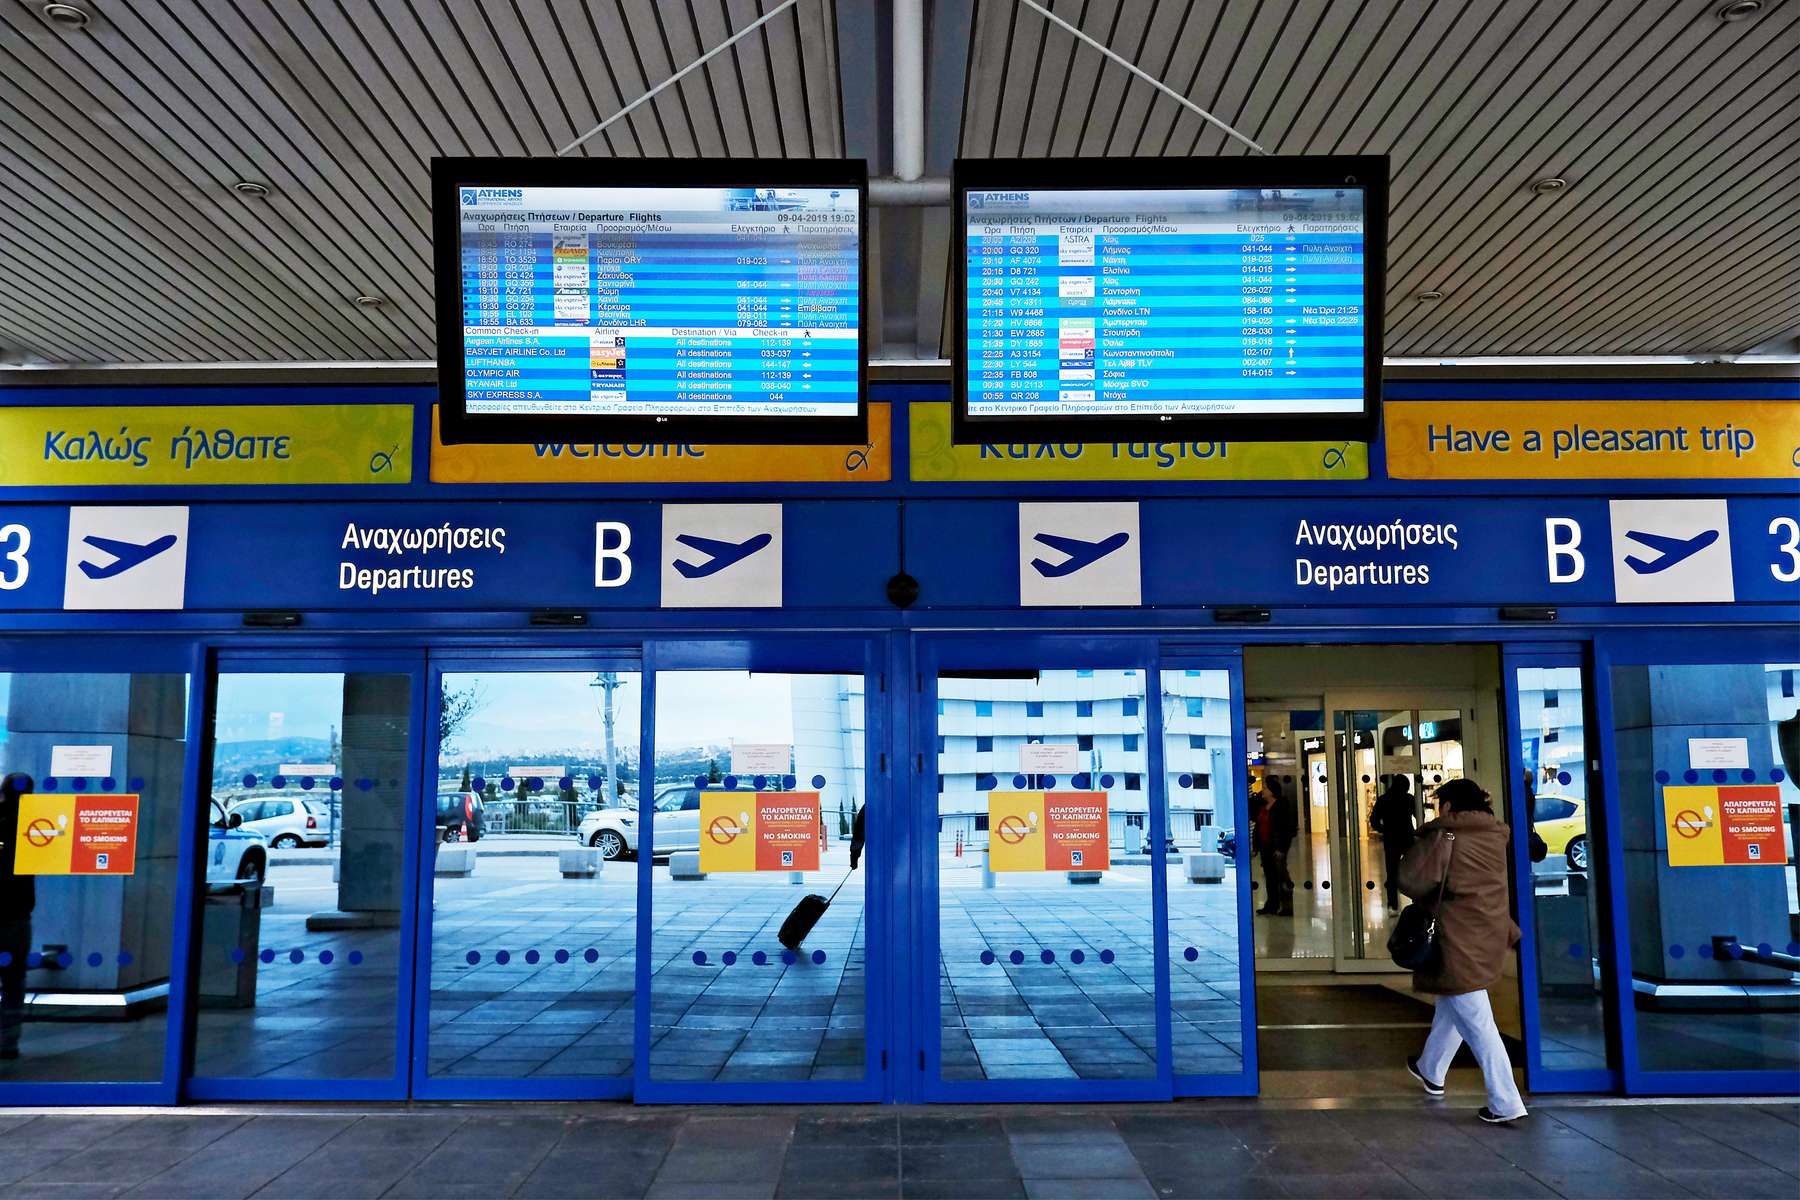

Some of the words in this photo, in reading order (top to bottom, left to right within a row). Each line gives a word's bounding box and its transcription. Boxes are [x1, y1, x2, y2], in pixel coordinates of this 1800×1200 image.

[478, 189, 523, 198] ATHENS
[985, 193, 1029, 201] ATHENS
[463, 213, 526, 223] Αναχωρήσεις
[528, 213, 570, 223] Πτήσεων
[578, 213, 624, 223] Departure
[630, 213, 662, 223] Flights
[777, 214, 828, 222] 09-04-2019
[831, 214, 856, 222] 19:02
[1084, 214, 1130, 224] Departure
[1135, 214, 1167, 224] Flights
[1010, 247, 1024, 255] GQ
[1010, 267, 1022, 275] D8
[1022, 267, 1037, 275] 721
[1242, 265, 1273, 273] 014-015
[1010, 288, 1022, 296] V7
[982, 309, 1004, 317] 21:15
[1010, 309, 1023, 317] W9
[1134, 308, 1151, 316] LTN
[629, 319, 647, 327] LHR
[465, 327, 502, 335] Common
[504, 327, 540, 335] Check-in
[594, 327, 620, 335] Airline
[671, 328, 717, 336] Destination
[723, 328, 737, 336] Via
[752, 329, 788, 337] Check-in
[982, 329, 1004, 337] 21:30
[1010, 329, 1025, 337] EW
[466, 348, 502, 356] EASYJET
[505, 348, 537, 356] AIRLINE
[676, 350, 686, 358] All
[688, 350, 732, 358] destinations
[760, 350, 792, 358] 033-037
[1010, 350, 1022, 358] A3
[676, 371, 687, 379] All
[688, 371, 732, 379] destinations
[467, 391, 484, 399] SKY
[486, 391, 526, 399] EXPRESS
[677, 392, 687, 400] All
[688, 392, 732, 400] destinations
[1010, 392, 1025, 400] QR
[1427, 424, 1510, 452] Have
[1522, 430, 1542, 452] a
[1553, 424, 1688, 459] pleasant
[1700, 423, 1755, 458] trip
[44, 426, 152, 467] Καλώς
[170, 426, 291, 469] ήλθατε
[341, 522, 506, 554] Αναχωρήσεις
[1295, 518, 1458, 550] Αναχωρήσεις
[595, 521, 632, 588] B
[1545, 517, 1585, 583] B
[1768, 516, 1800, 583] 3
[0, 524, 31, 590] 3
[339, 562, 474, 595] Departures
[1295, 558, 1429, 591] Departures
